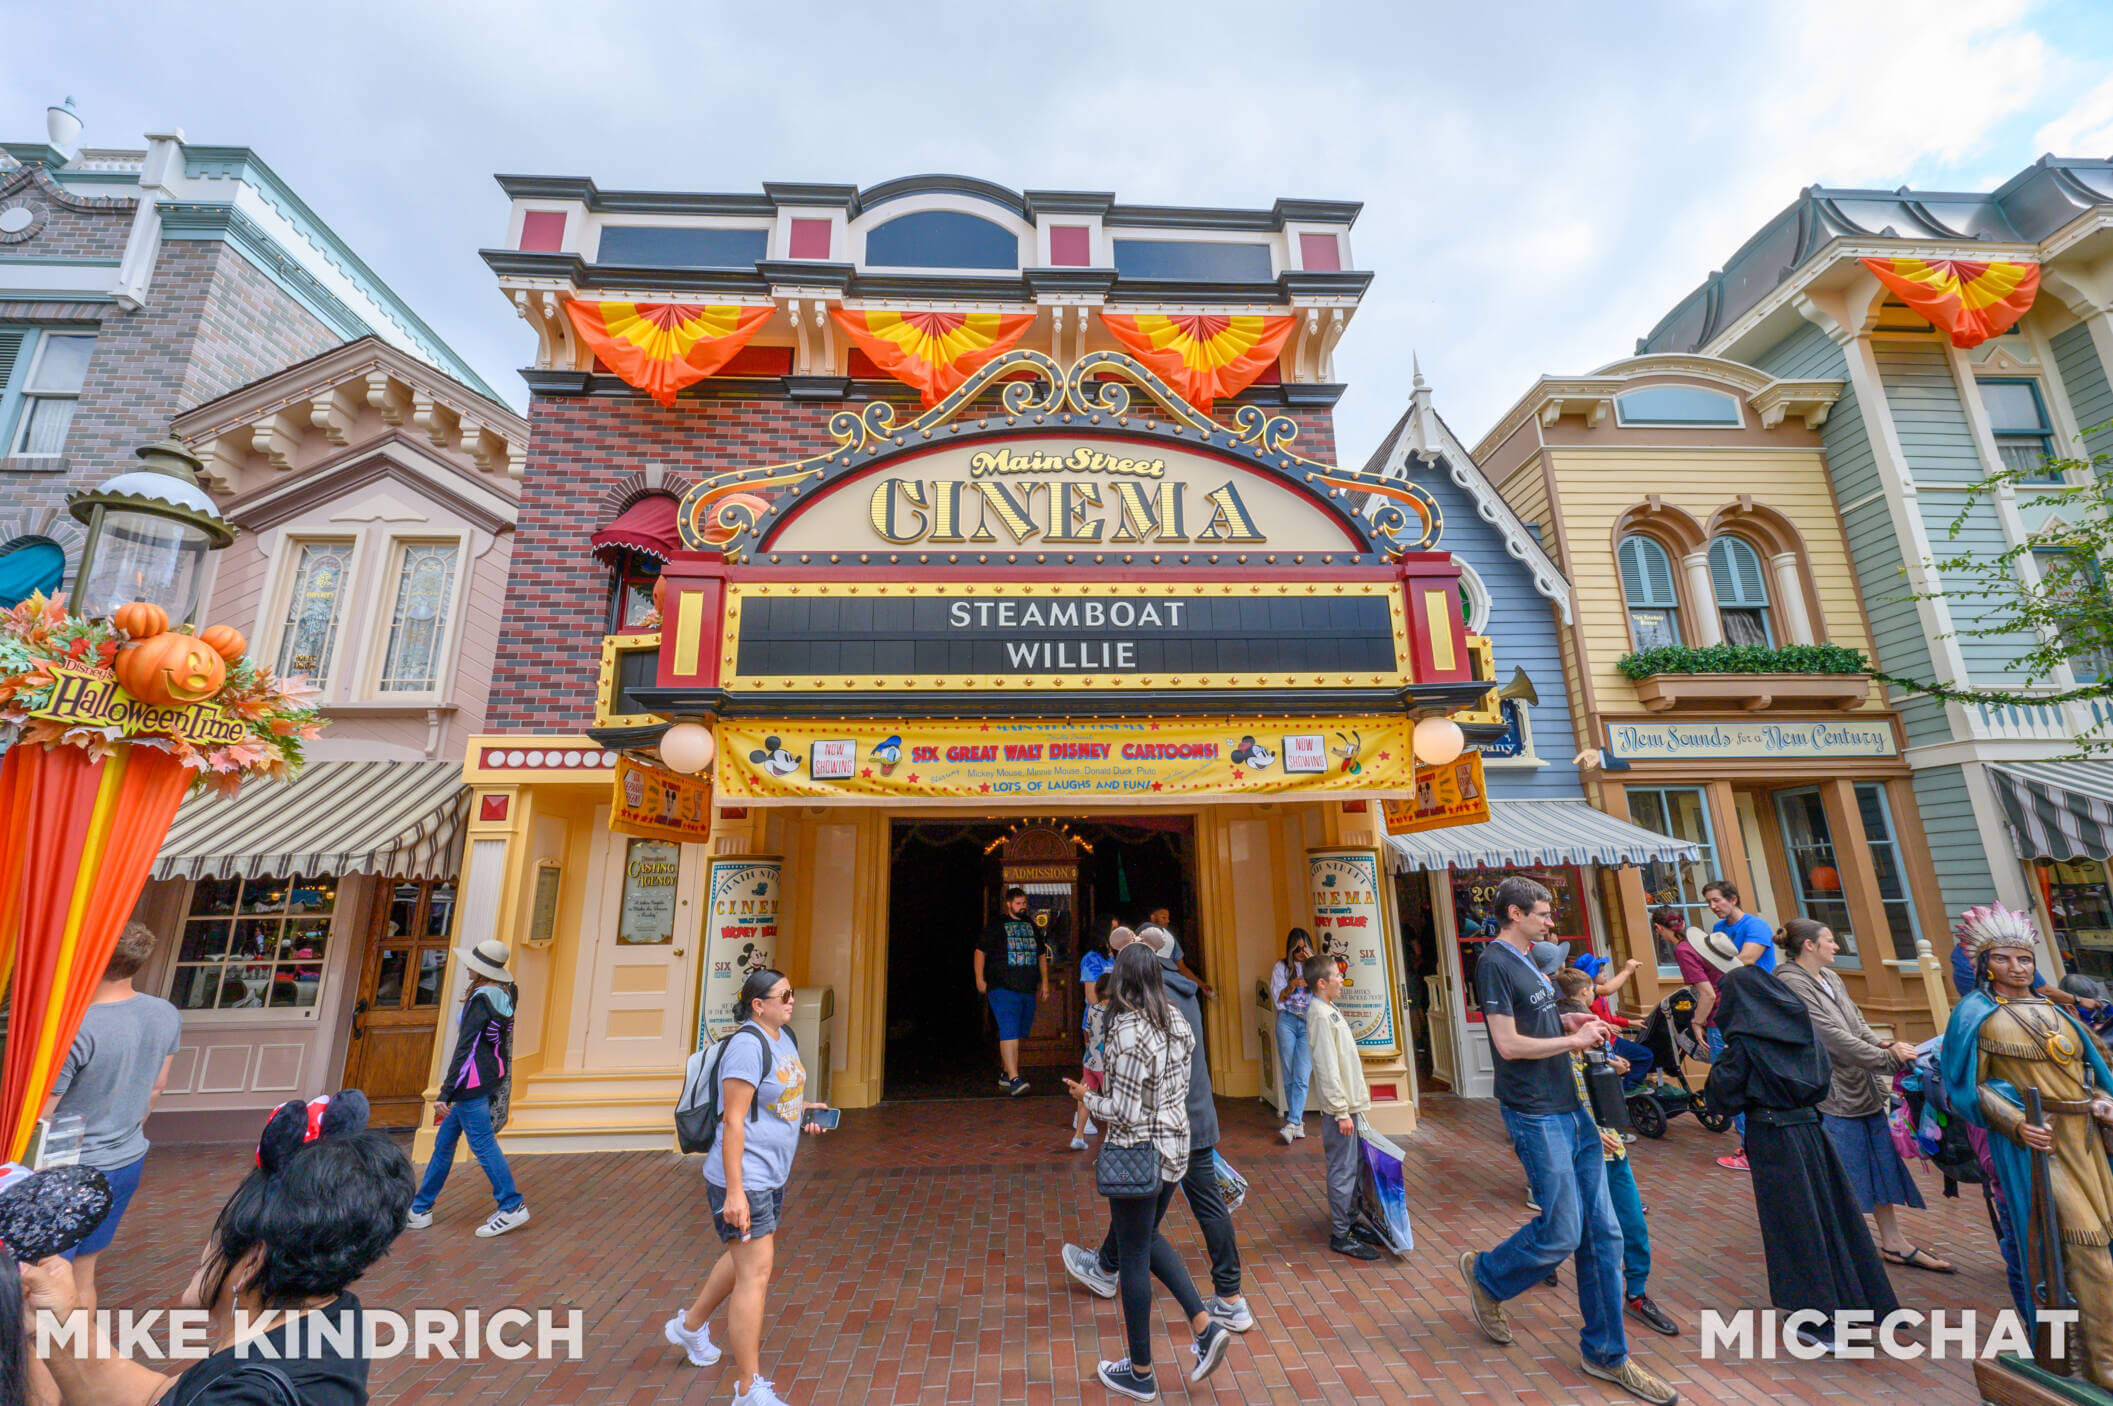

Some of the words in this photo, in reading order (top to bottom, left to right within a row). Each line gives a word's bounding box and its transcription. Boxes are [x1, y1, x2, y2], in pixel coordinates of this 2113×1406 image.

[971, 448, 1065, 477] Main
[1064, 447, 1165, 479] Street
[868, 478, 1268, 545] CINEMA
[950, 600, 1185, 628] STEAMBOAT
[1006, 641, 1138, 669] WILLIE
[64, 659, 114, 681] Disney's
[1295, 739, 1314, 752] NOW
[1617, 726, 1664, 752] New
[1666, 725, 1732, 752] Sounds
[1736, 731, 1753, 744] for
[1762, 724, 1808, 750] New
[1810, 723, 1888, 752] Century
[824, 743, 845, 757] NOW
[911, 745, 940, 763] SIX
[946, 744, 999, 763] GREAT
[1003, 743, 1044, 762] WALT
[1049, 743, 1111, 760] DISNEY
[1121, 742, 1219, 760] CARTOONS!
[815, 758, 852, 776] SHOWING
[1288, 753, 1325, 770] SHOWING
[967, 769, 995, 778] Mickey
[1026, 768, 1051, 776] Minnie
[1084, 766, 1111, 775] Donald
[1136, 766, 1157, 775] Pluto
[993, 782, 1022, 792] LOTS
[1027, 781, 1043, 791] OF
[1048, 780, 1092, 790] LAUGHS
[1096, 780, 1120, 790] AND
[1123, 780, 1152, 790] FUN!
[627, 859, 676, 878] CASTING
[1013, 867, 1069, 880] ADMISSION
[636, 875, 677, 888] AGENCY
[1360, 949, 1376, 959] SIX
[714, 961, 732, 971] SIX
